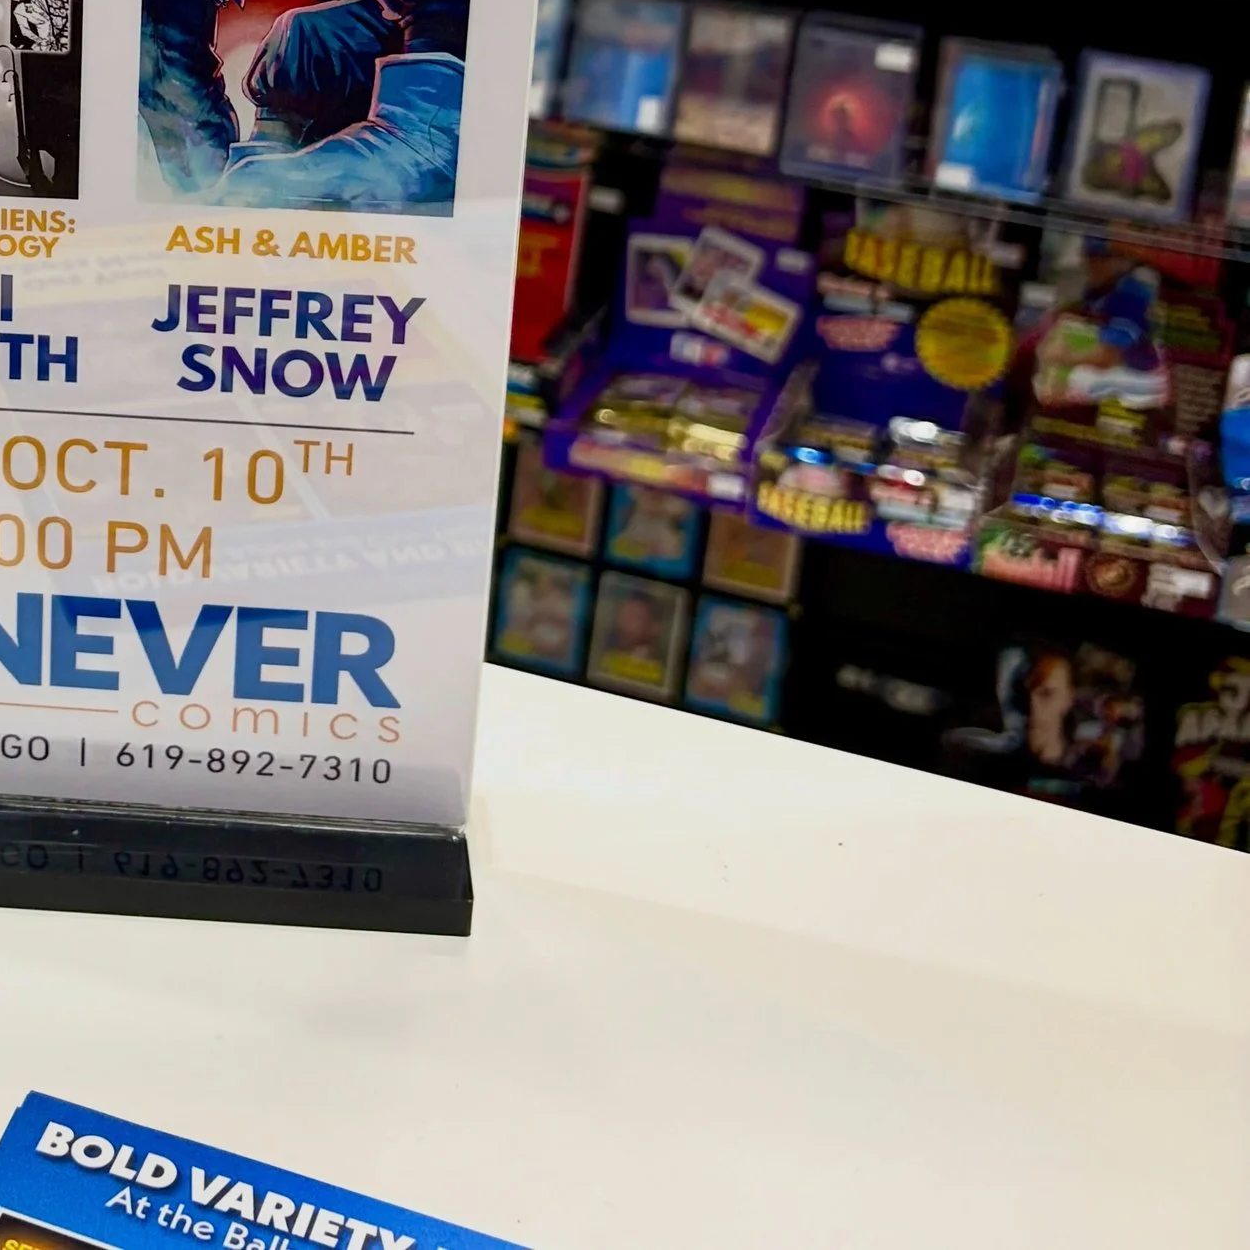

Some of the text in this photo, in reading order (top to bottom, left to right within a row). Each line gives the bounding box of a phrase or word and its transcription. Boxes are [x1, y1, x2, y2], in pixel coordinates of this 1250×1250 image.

[165, 225, 417, 264] ASH & AMBER
[151, 284, 427, 344] JEFFREY
[177, 344, 397, 402] SNOW
[2, 435, 165, 498] OCT.
[107, 521, 213, 579] PM
[116, 742, 392, 784] 619-892-7310
[34, 1120, 416, 1250] BOLD VARIETY
[105, 1186, 151, 1220] At
[157, 1204, 215, 1241] the
